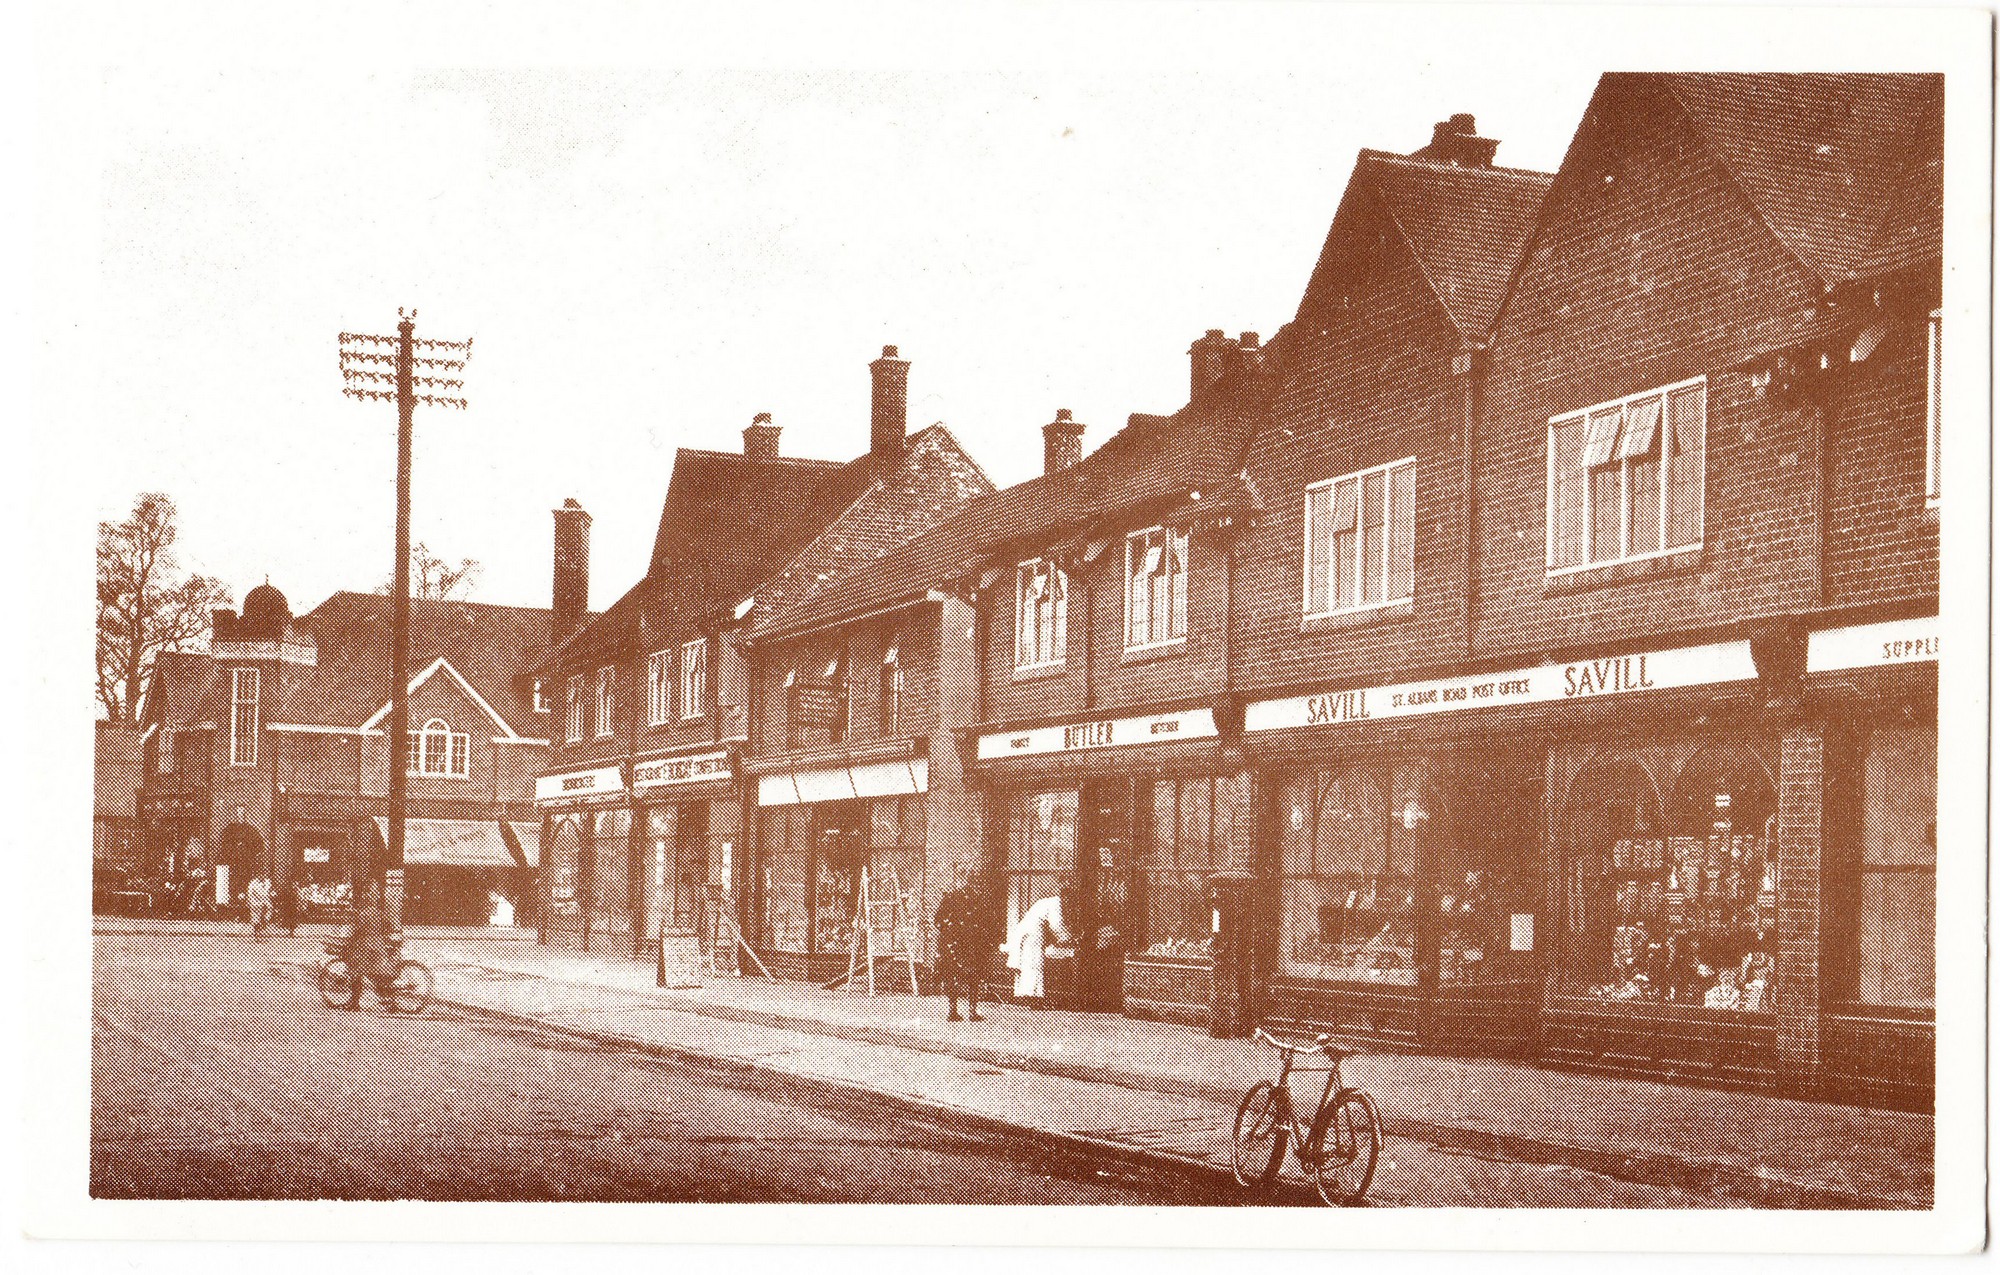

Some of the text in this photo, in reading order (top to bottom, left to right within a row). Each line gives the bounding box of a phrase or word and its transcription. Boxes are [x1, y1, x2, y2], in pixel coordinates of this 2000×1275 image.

[1442, 686, 1468, 702] ROAD
[1471, 683, 1496, 699] POST
[1498, 678, 1531, 697] OFFICE
[1563, 655, 1655, 698] SAVILL
[1306, 690, 1371, 724] SAVILL
[1064, 722, 1114, 749] BUTLER
